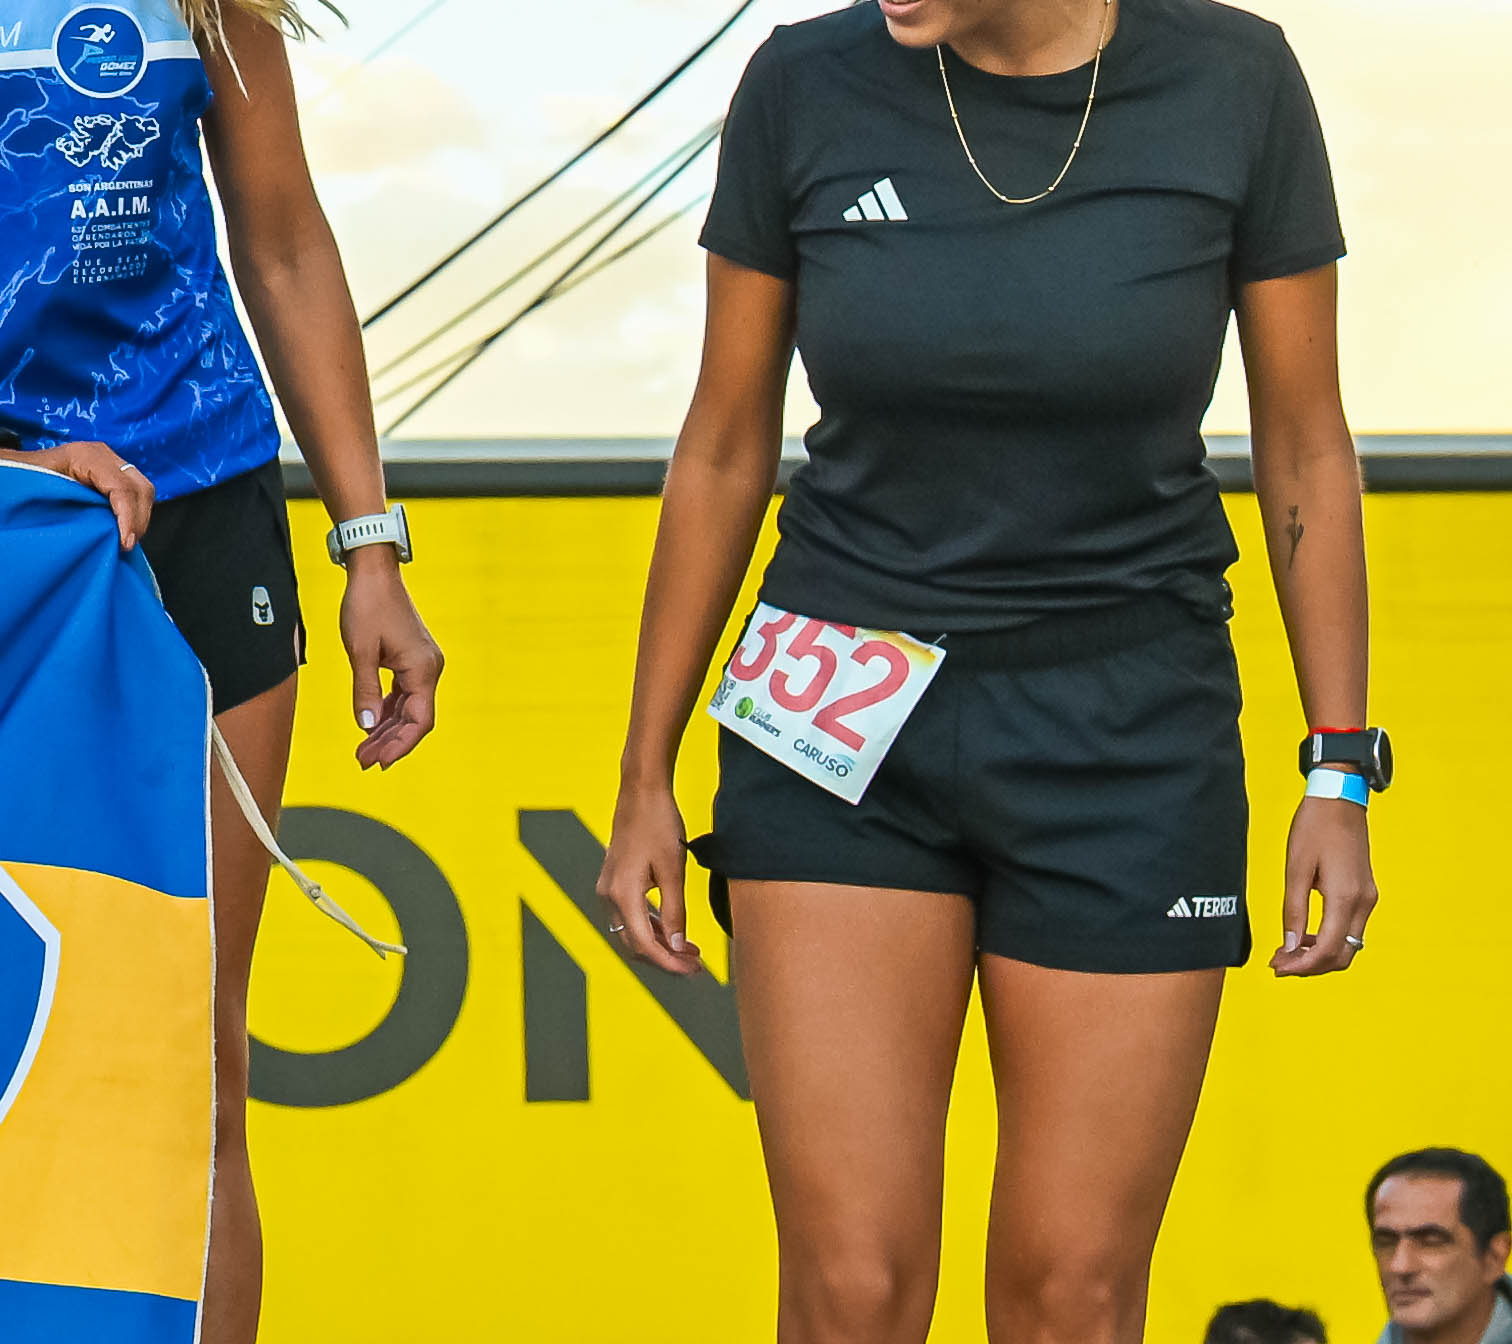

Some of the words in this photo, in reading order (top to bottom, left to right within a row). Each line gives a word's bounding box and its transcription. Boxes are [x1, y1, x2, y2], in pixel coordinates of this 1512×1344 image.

[71, 195, 151, 220] A.A.I.M.
[72, 258, 101, 268] QUE
[730, 613, 910, 753] 352
[793, 738, 849, 778] CARUSO
[1192, 895, 1238, 918] TERREX
